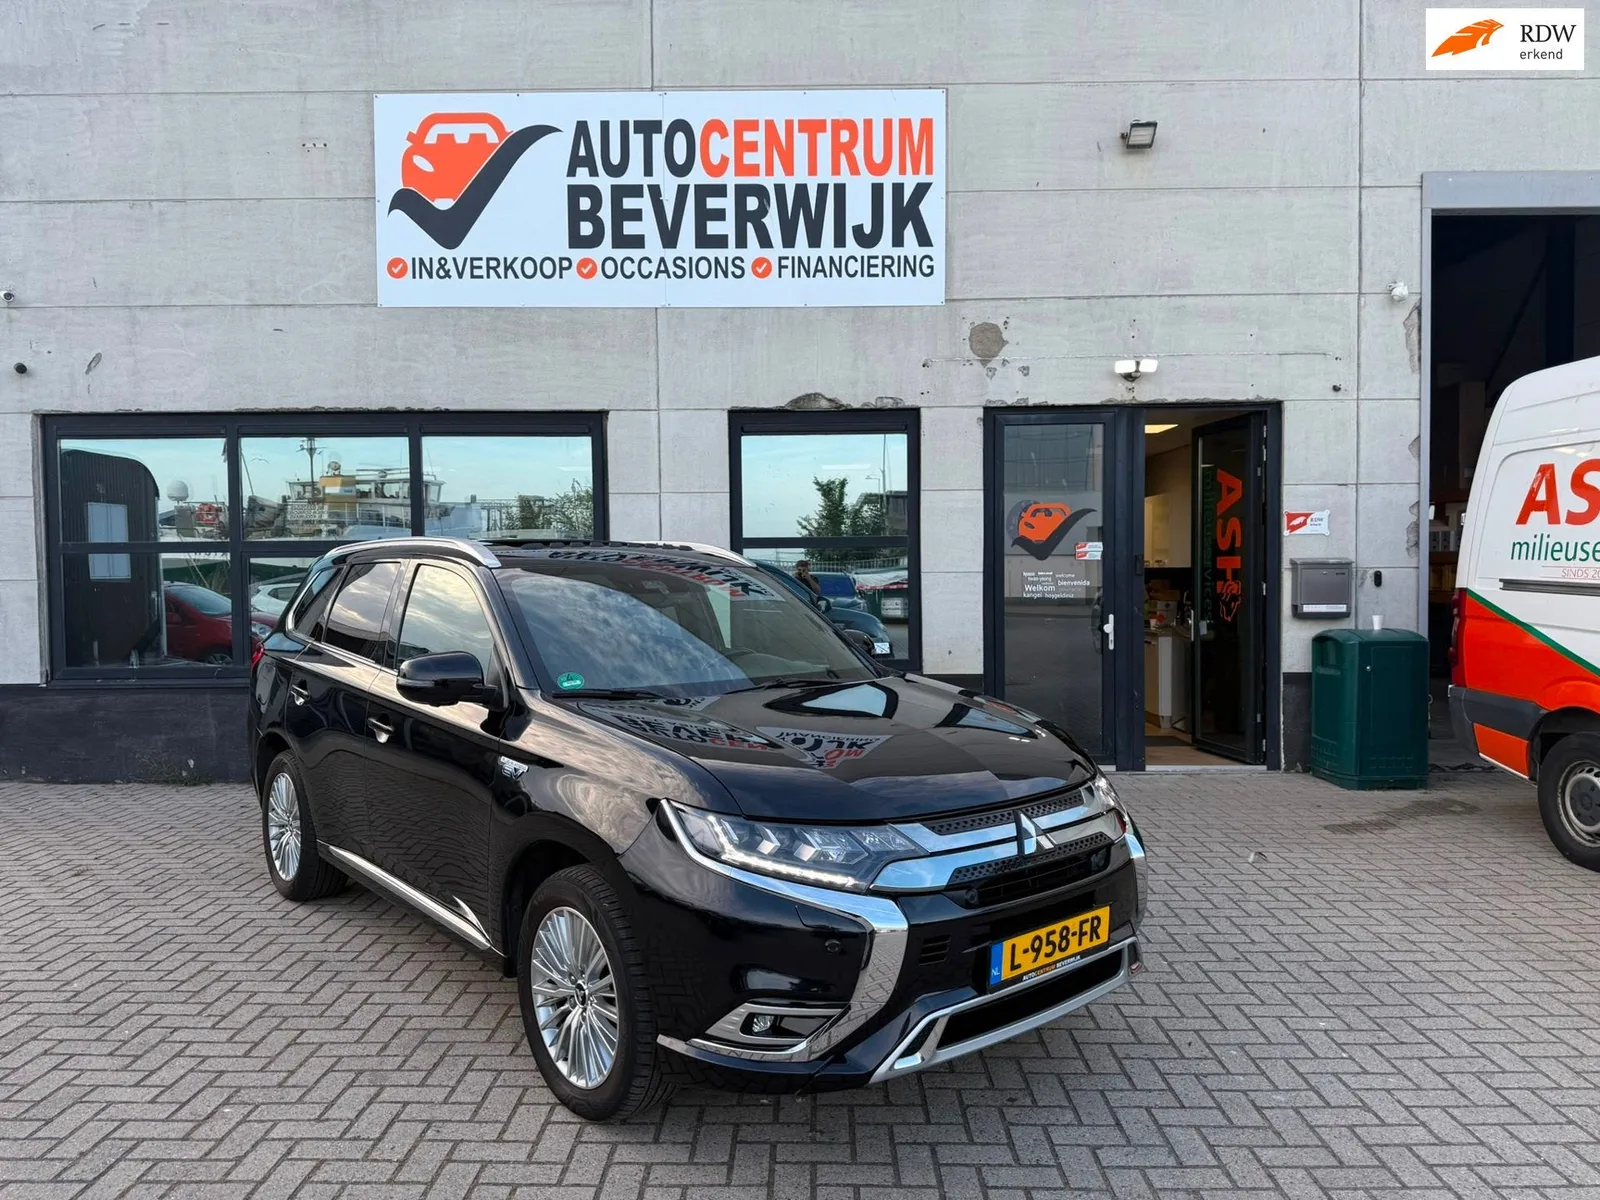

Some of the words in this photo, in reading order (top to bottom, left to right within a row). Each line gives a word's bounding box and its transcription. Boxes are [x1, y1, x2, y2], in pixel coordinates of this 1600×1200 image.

[566, 118, 934, 178] AUTOCENTRUM
[567, 182, 934, 250] BEVERWIJK
[411, 255, 573, 280] IN&VERKOOP
[601, 255, 746, 280] OCCASIONS
[777, 254, 935, 279] FINANCIERING
[1216, 468, 1243, 594] ASH
[1562, 568, 1589, 578] SINDS
[1024, 584, 1056, 592] Welkom
[1010, 914, 1102, 972] L-958-FR
[991, 966, 1001, 977] NL
[1022, 964, 1056, 981] AUTOCENTRUM
